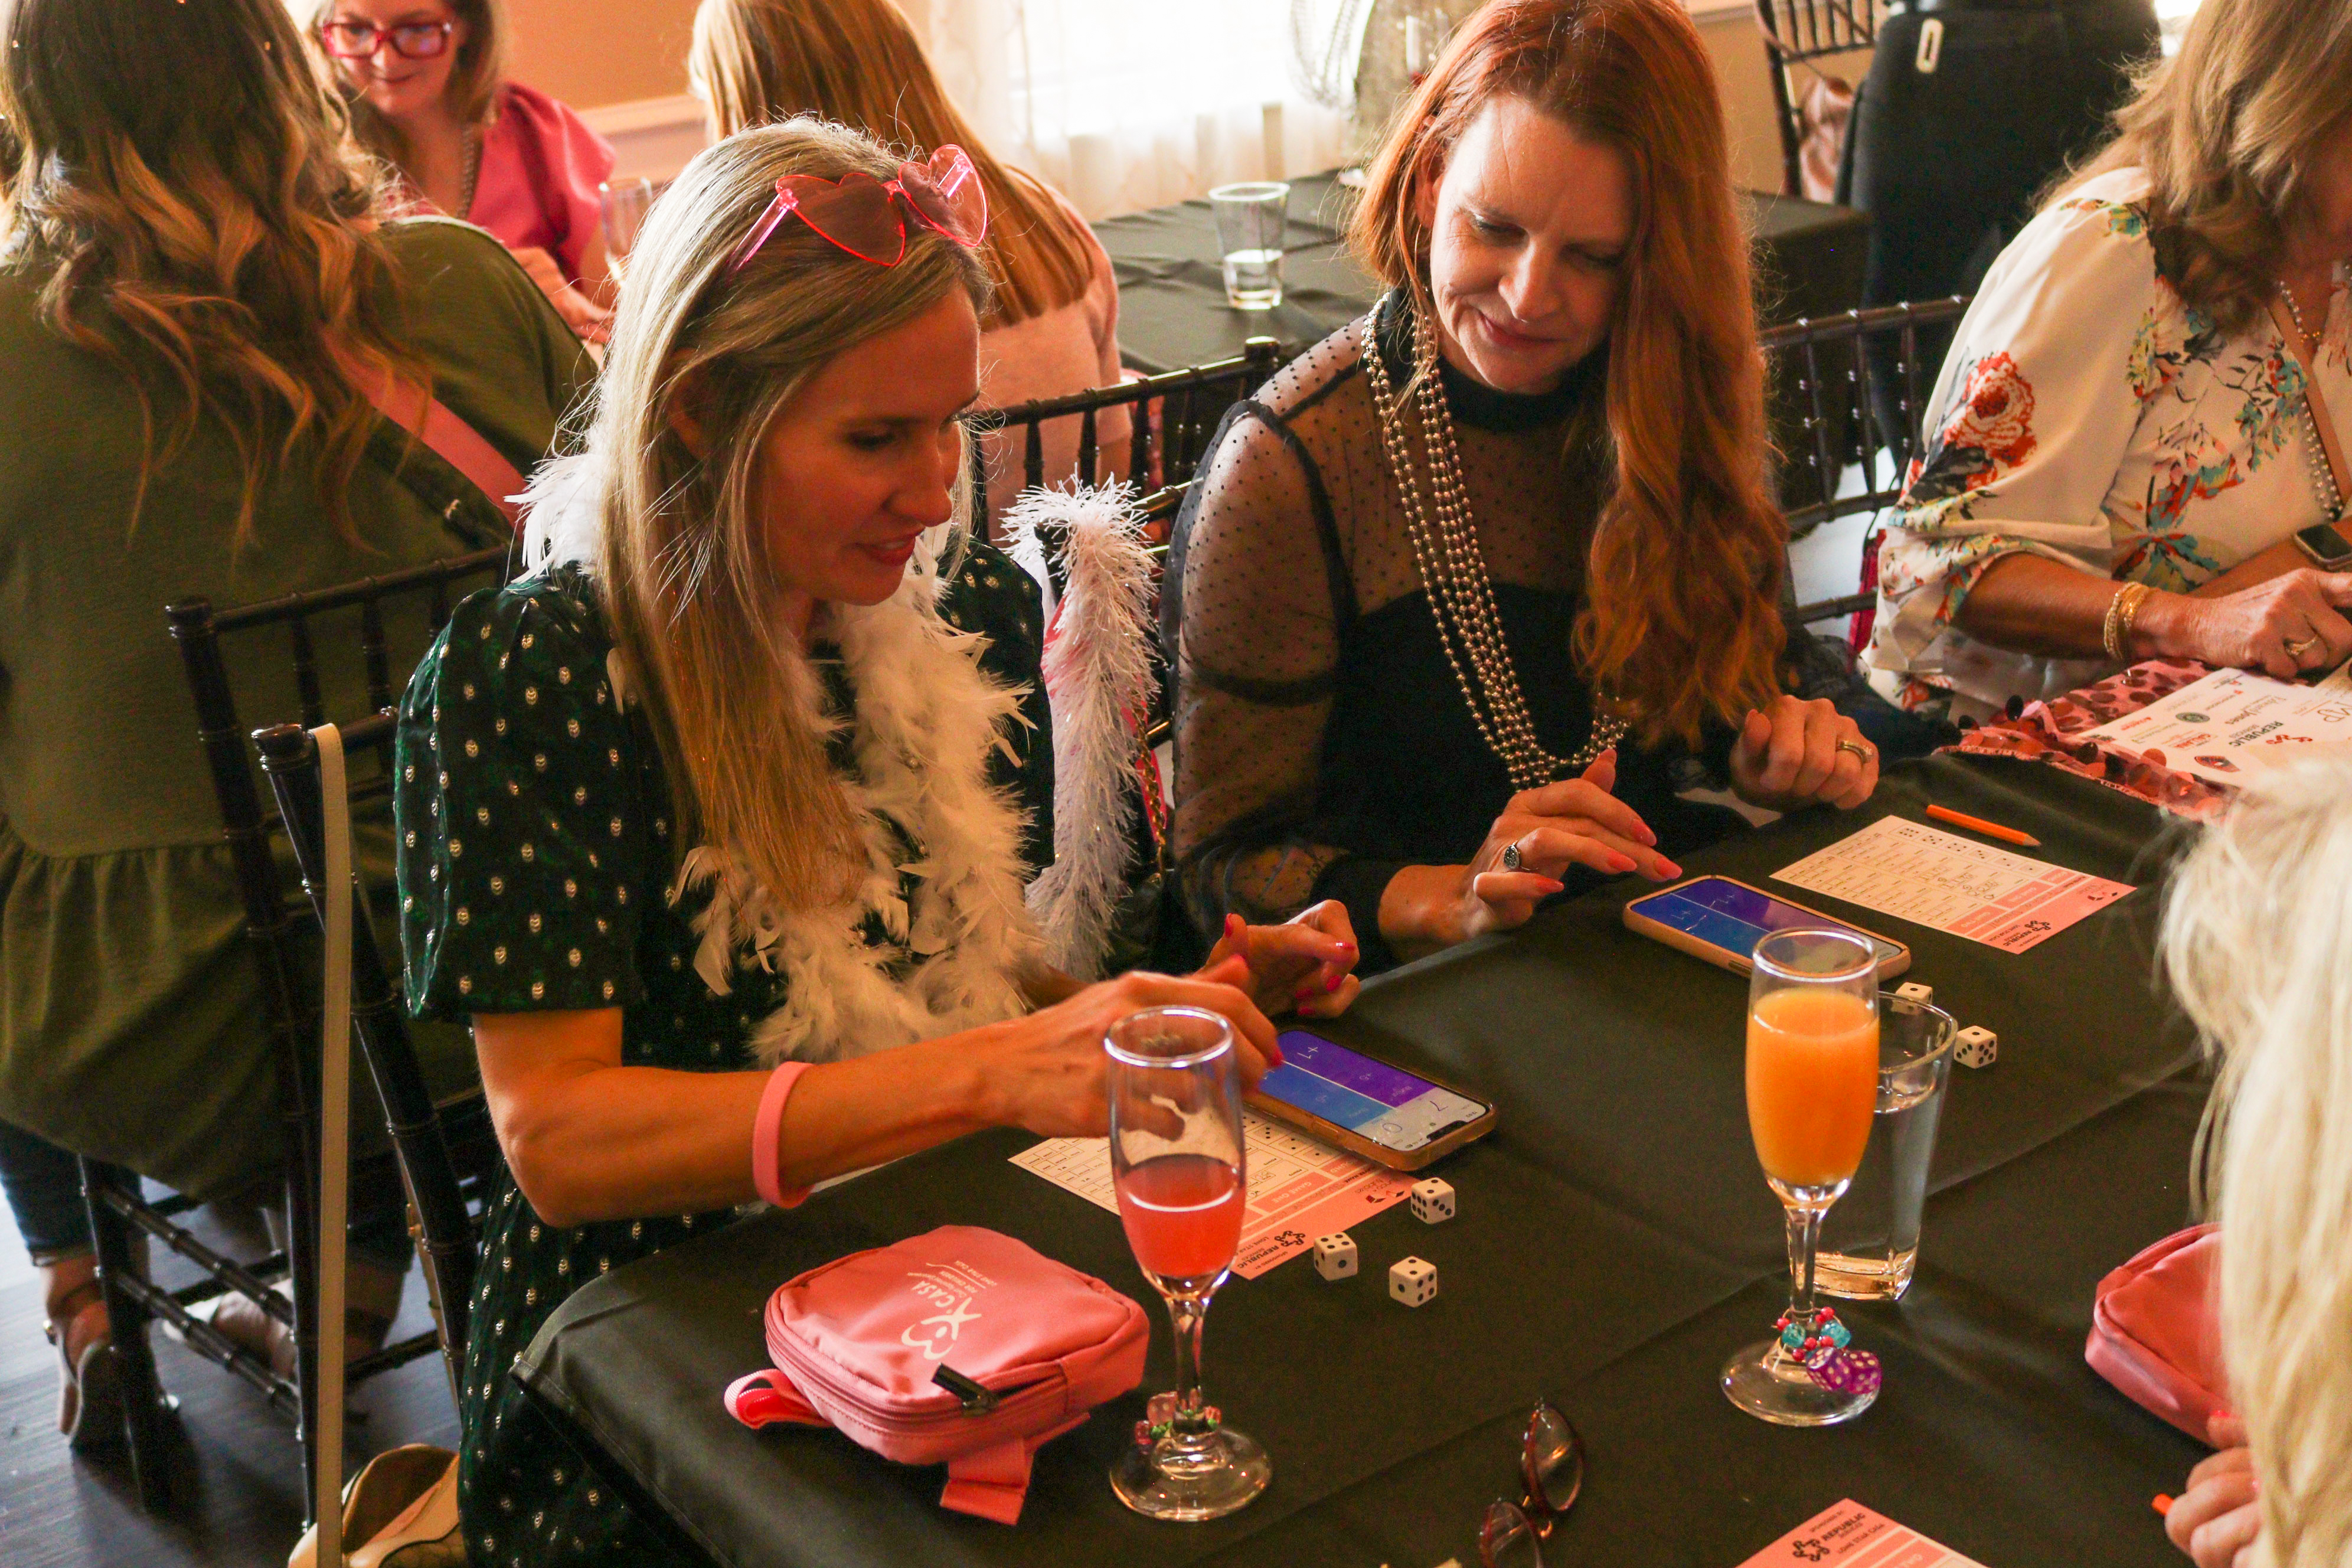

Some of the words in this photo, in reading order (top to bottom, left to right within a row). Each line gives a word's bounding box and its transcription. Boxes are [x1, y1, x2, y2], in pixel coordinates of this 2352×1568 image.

[2228, 720, 2284, 747] REPUBLIC
[2003, 930, 2033, 946] REPUBLIC
[1297, 1046, 1319, 1060] +1
[1430, 1100, 1448, 1112] 7
[1288, 1181, 1312, 1194] GAME
[1271, 1193, 1290, 1203] ONE
[1237, 1244, 1279, 1269] REPUBLIC
[912, 1280, 956, 1308] CASA
[1821, 1513, 1866, 1541] REPUBLIC
